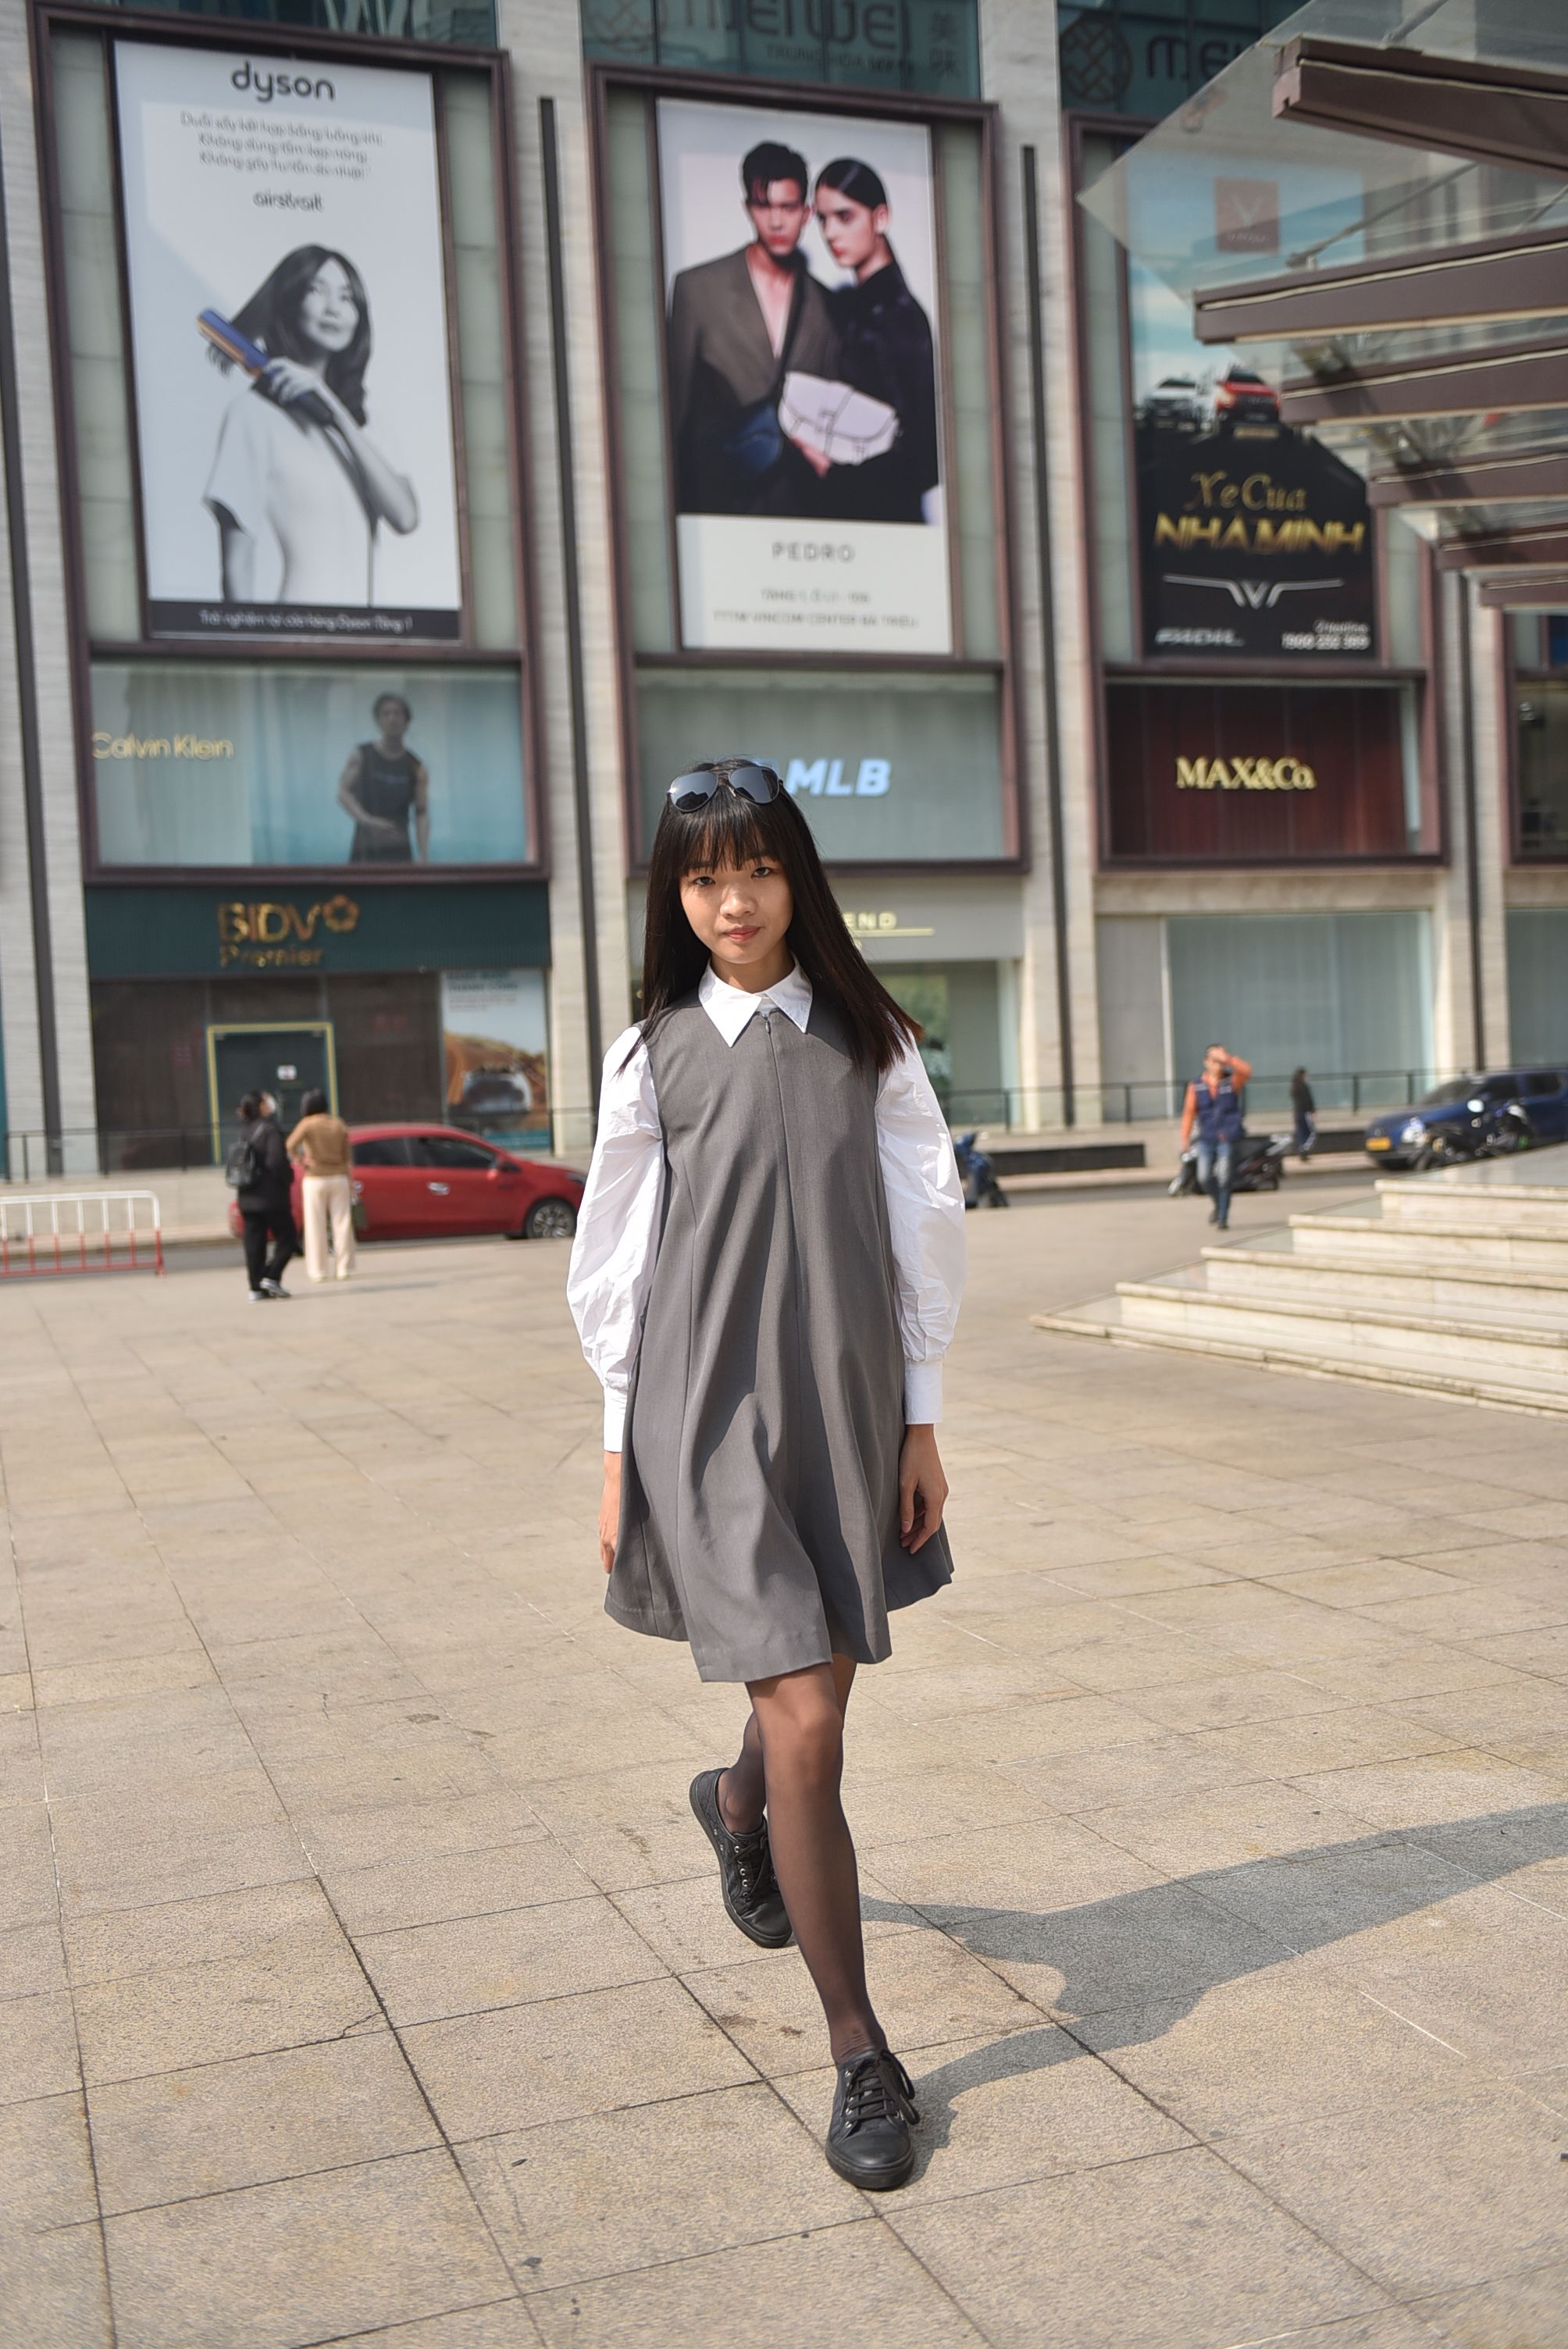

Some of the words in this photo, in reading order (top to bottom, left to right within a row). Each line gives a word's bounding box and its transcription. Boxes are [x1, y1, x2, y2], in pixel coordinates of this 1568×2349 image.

[232, 60, 334, 102] dyson
[771, 542, 855, 563] PEDRO
[92, 732, 172, 761] Calvin
[173, 732, 233, 761] Klein
[785, 757, 893, 797] MLB
[218, 902, 322, 943] BIDV
[843, 911, 897, 930] END
[219, 944, 324, 968] Premier
